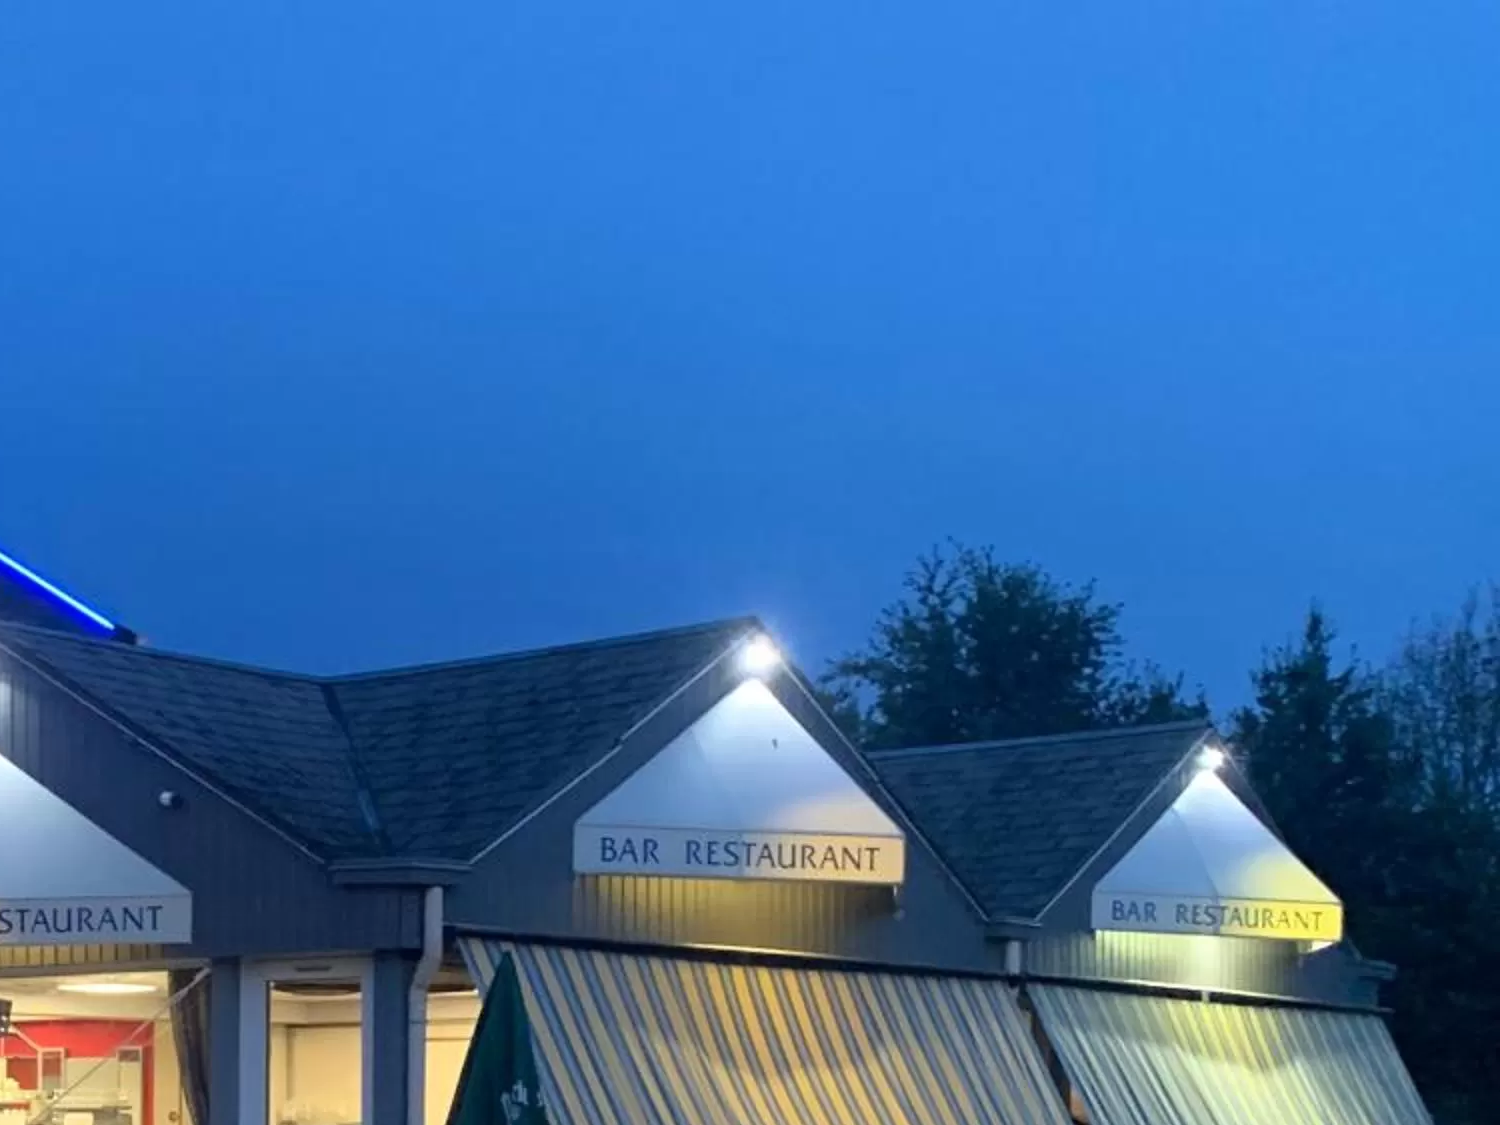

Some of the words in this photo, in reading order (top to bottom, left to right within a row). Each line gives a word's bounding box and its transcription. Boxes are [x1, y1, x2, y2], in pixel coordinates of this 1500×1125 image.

[600, 836, 660, 864] BAR
[685, 839, 881, 871] RESTAURANT
[1111, 900, 1157, 923] BAR
[1175, 903, 1325, 932] RESTAURANT
